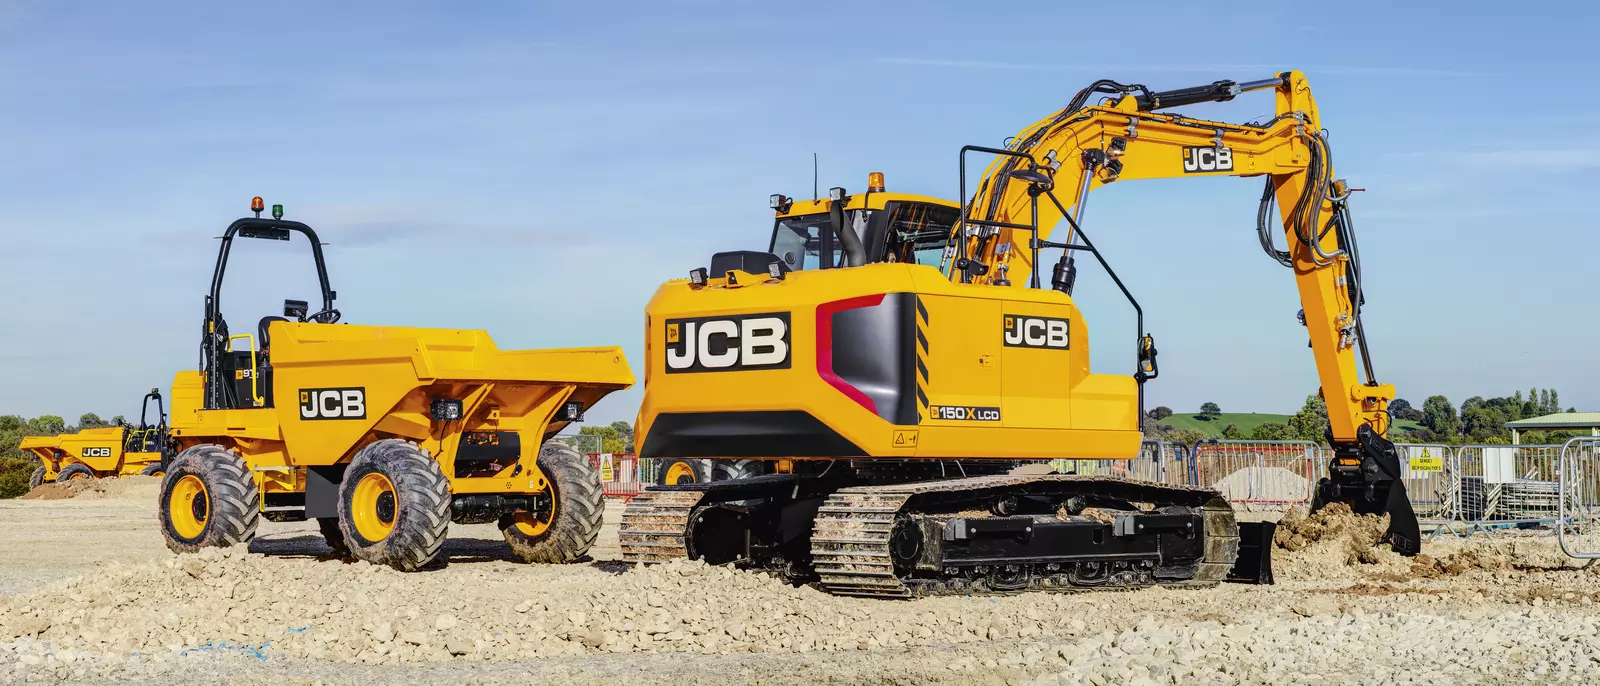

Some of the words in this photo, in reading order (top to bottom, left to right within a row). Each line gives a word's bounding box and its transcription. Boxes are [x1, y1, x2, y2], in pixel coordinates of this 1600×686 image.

[1184, 147, 1233, 171] JCB
[667, 317, 789, 368] JCB
[1005, 317, 1069, 347] JCB
[301, 390, 365, 418] JCB
[978, 411, 999, 420] LCD
[467, 432, 499, 446] JCB
[82, 448, 110, 457] JCB
